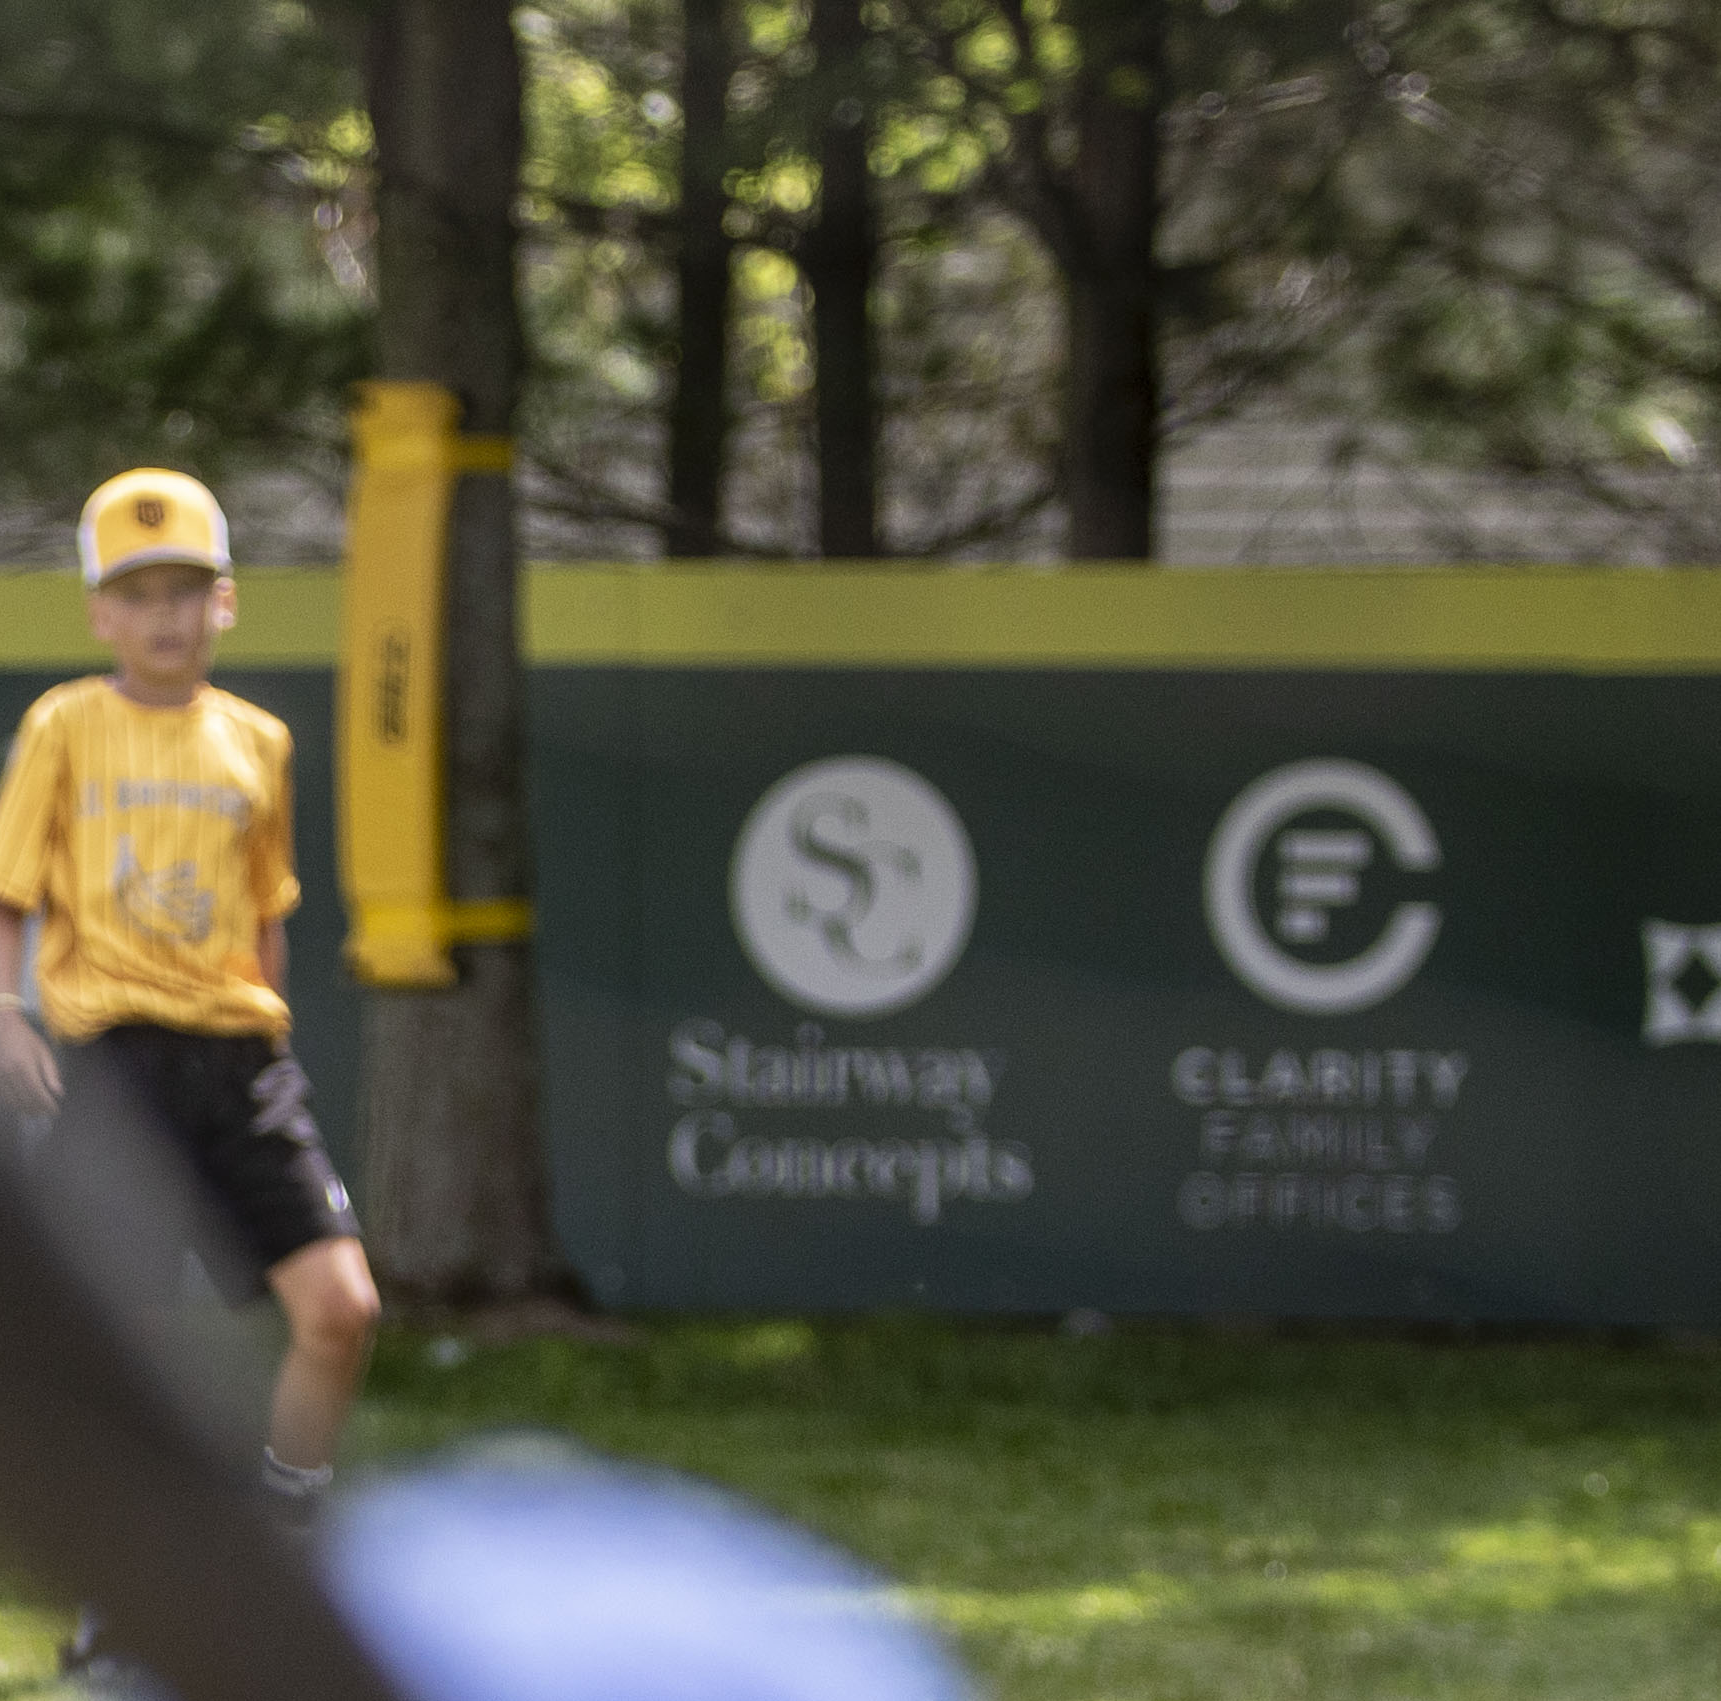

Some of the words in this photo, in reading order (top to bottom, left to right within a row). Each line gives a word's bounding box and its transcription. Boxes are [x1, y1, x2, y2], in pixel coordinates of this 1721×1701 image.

[1171, 1046, 1468, 1106] CLARITY
[1202, 1110, 1437, 1168] FAMILY
[1176, 1171, 1463, 1232] OFFICES
